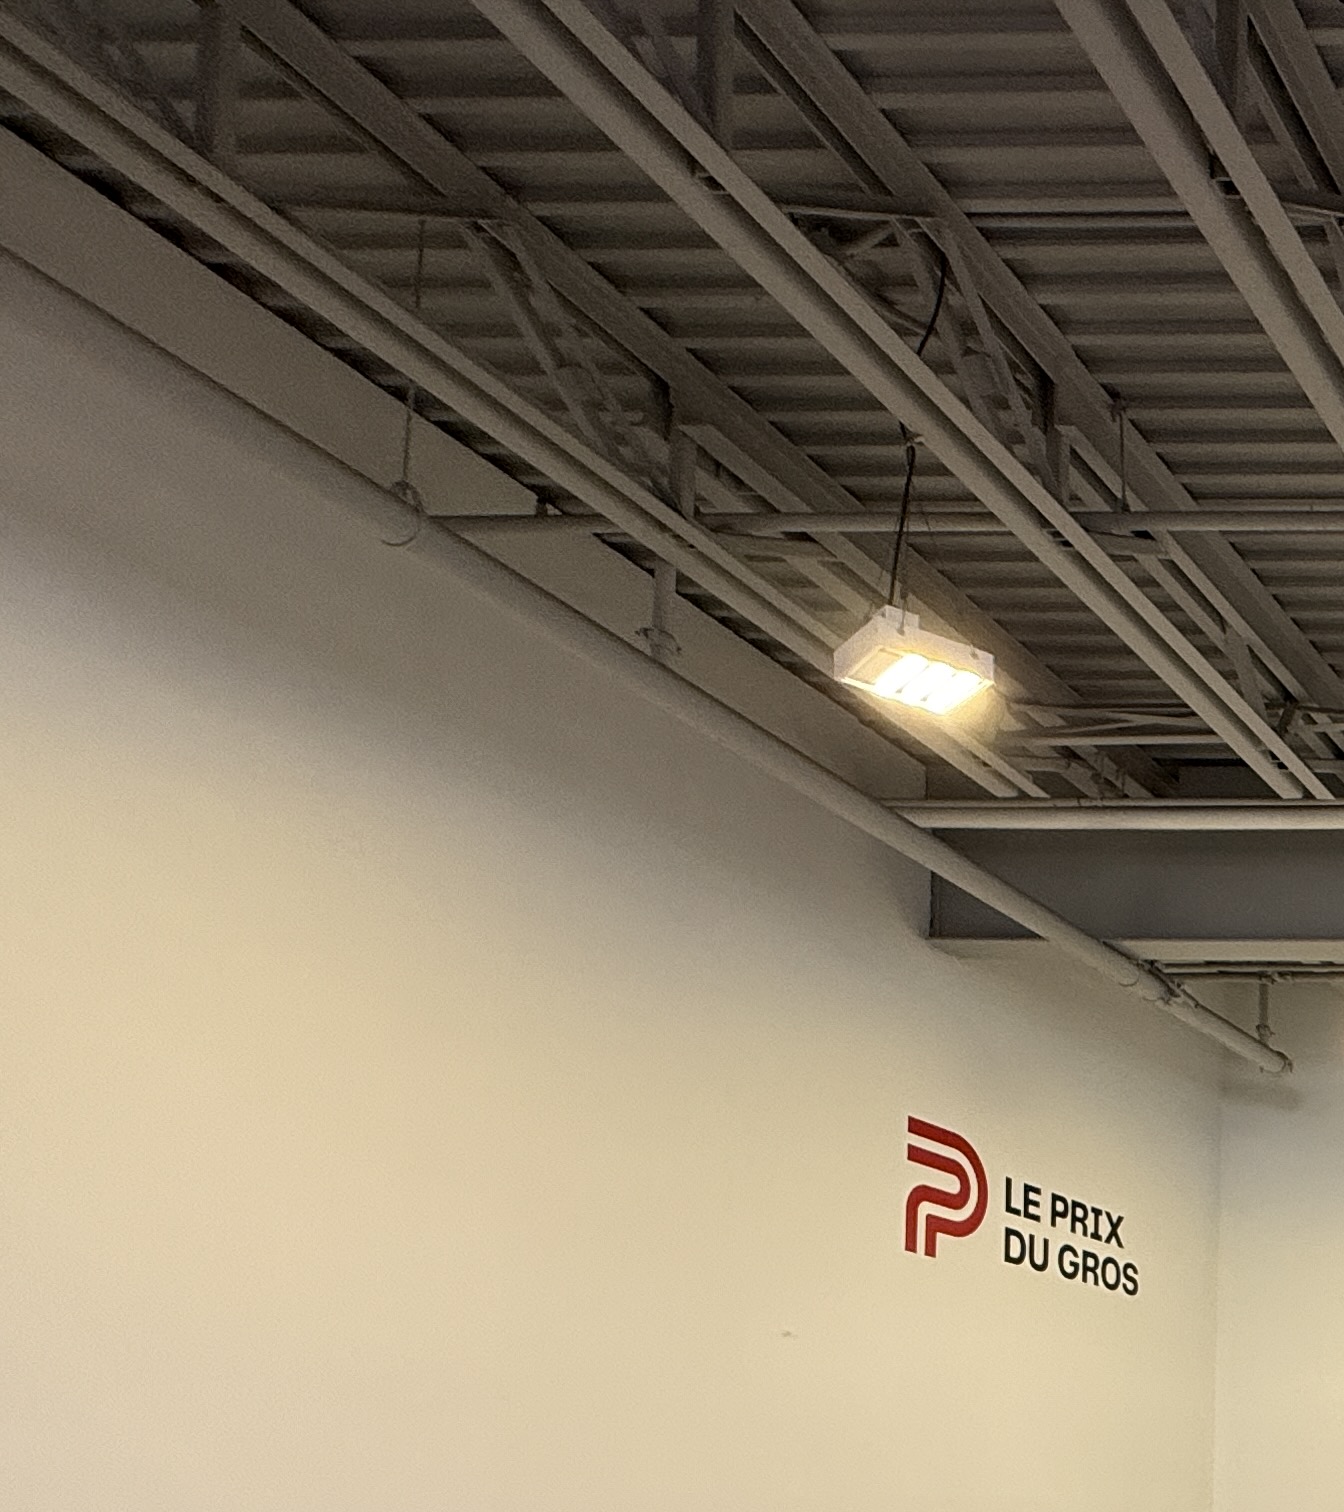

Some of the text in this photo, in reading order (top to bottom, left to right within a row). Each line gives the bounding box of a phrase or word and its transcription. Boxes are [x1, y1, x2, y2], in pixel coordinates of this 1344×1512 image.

[1005, 1176, 1125, 1249] LE PRIX
[1003, 1227, 1140, 1297] DU GROS
